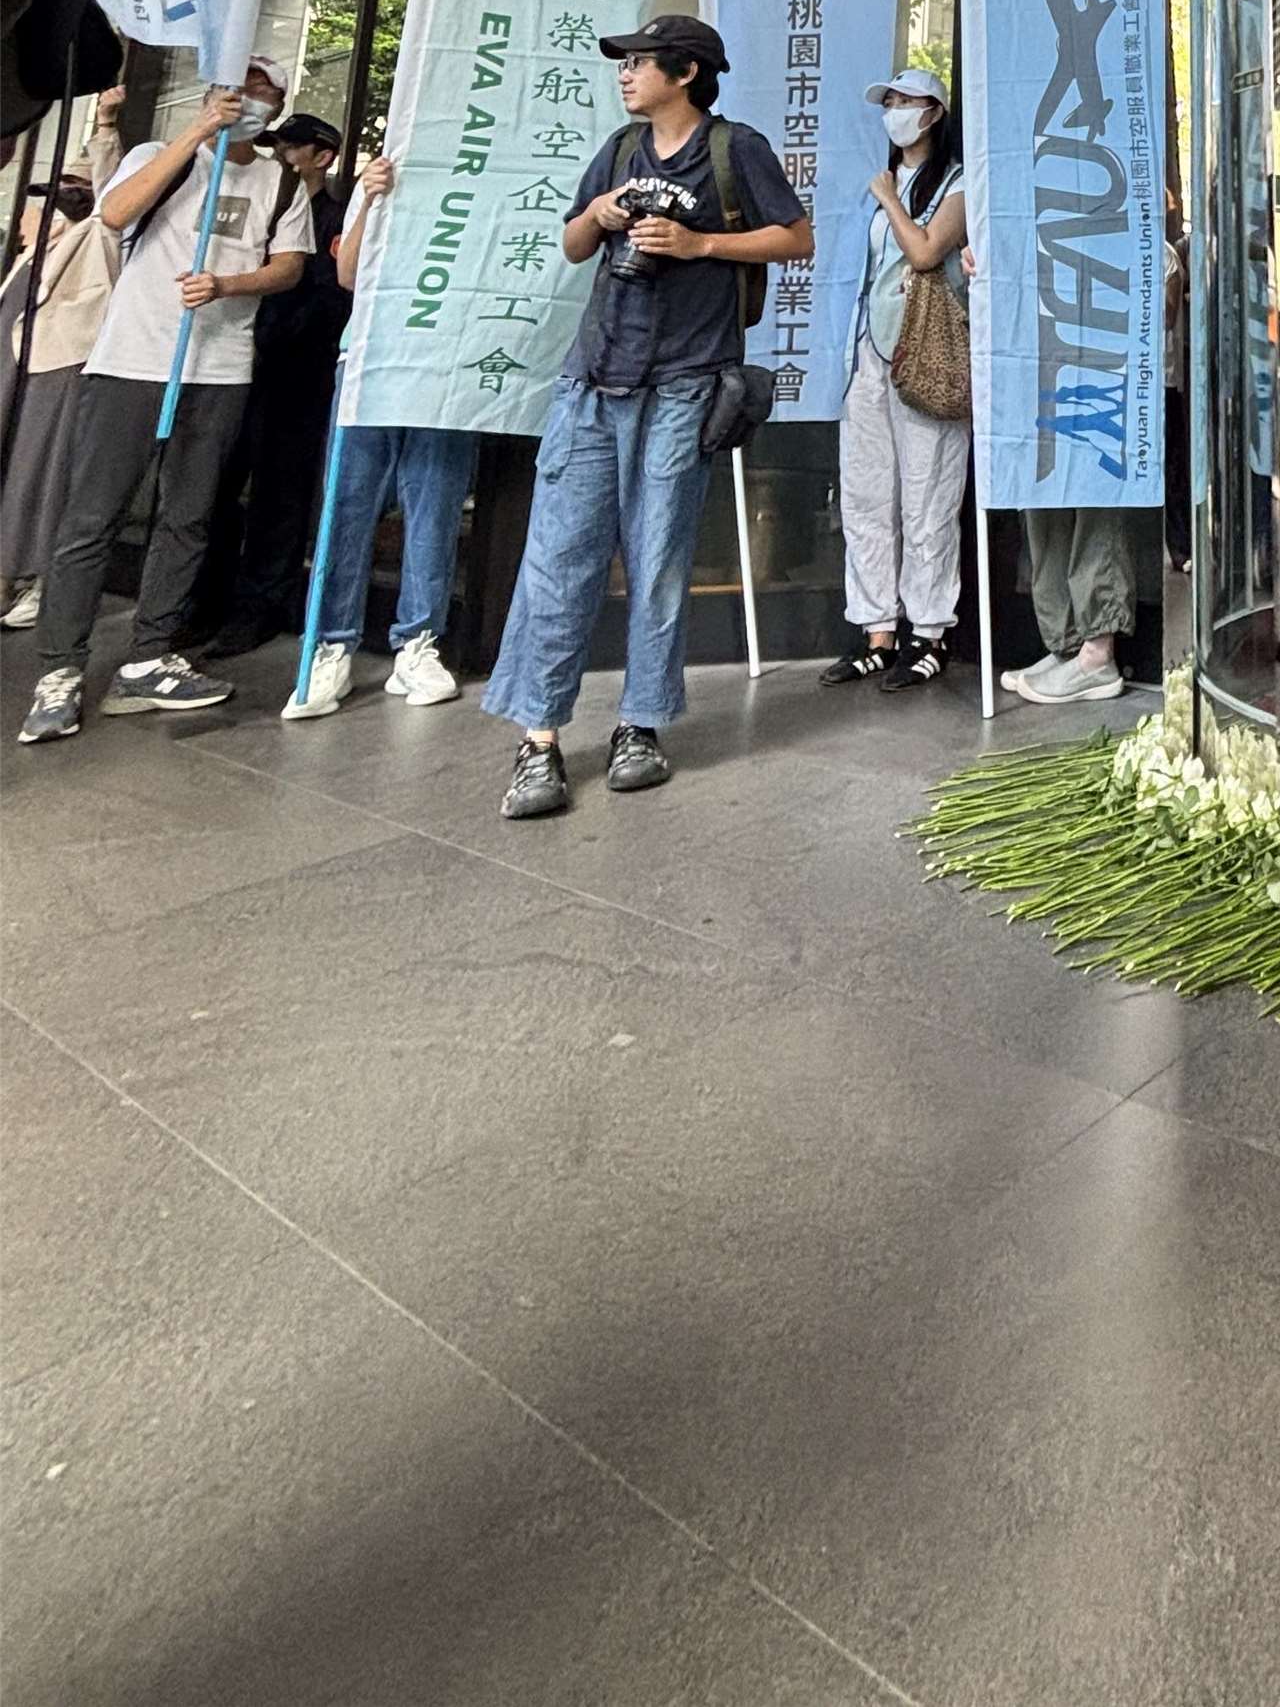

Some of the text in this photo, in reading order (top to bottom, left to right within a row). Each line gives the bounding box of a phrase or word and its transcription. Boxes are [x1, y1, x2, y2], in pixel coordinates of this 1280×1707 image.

[405, 11, 512, 329] EVA AIR UNION
[1139, 202, 1153, 253] Union
[1138, 255, 1152, 346] Attendants
[1138, 351, 1153, 400] Flight
